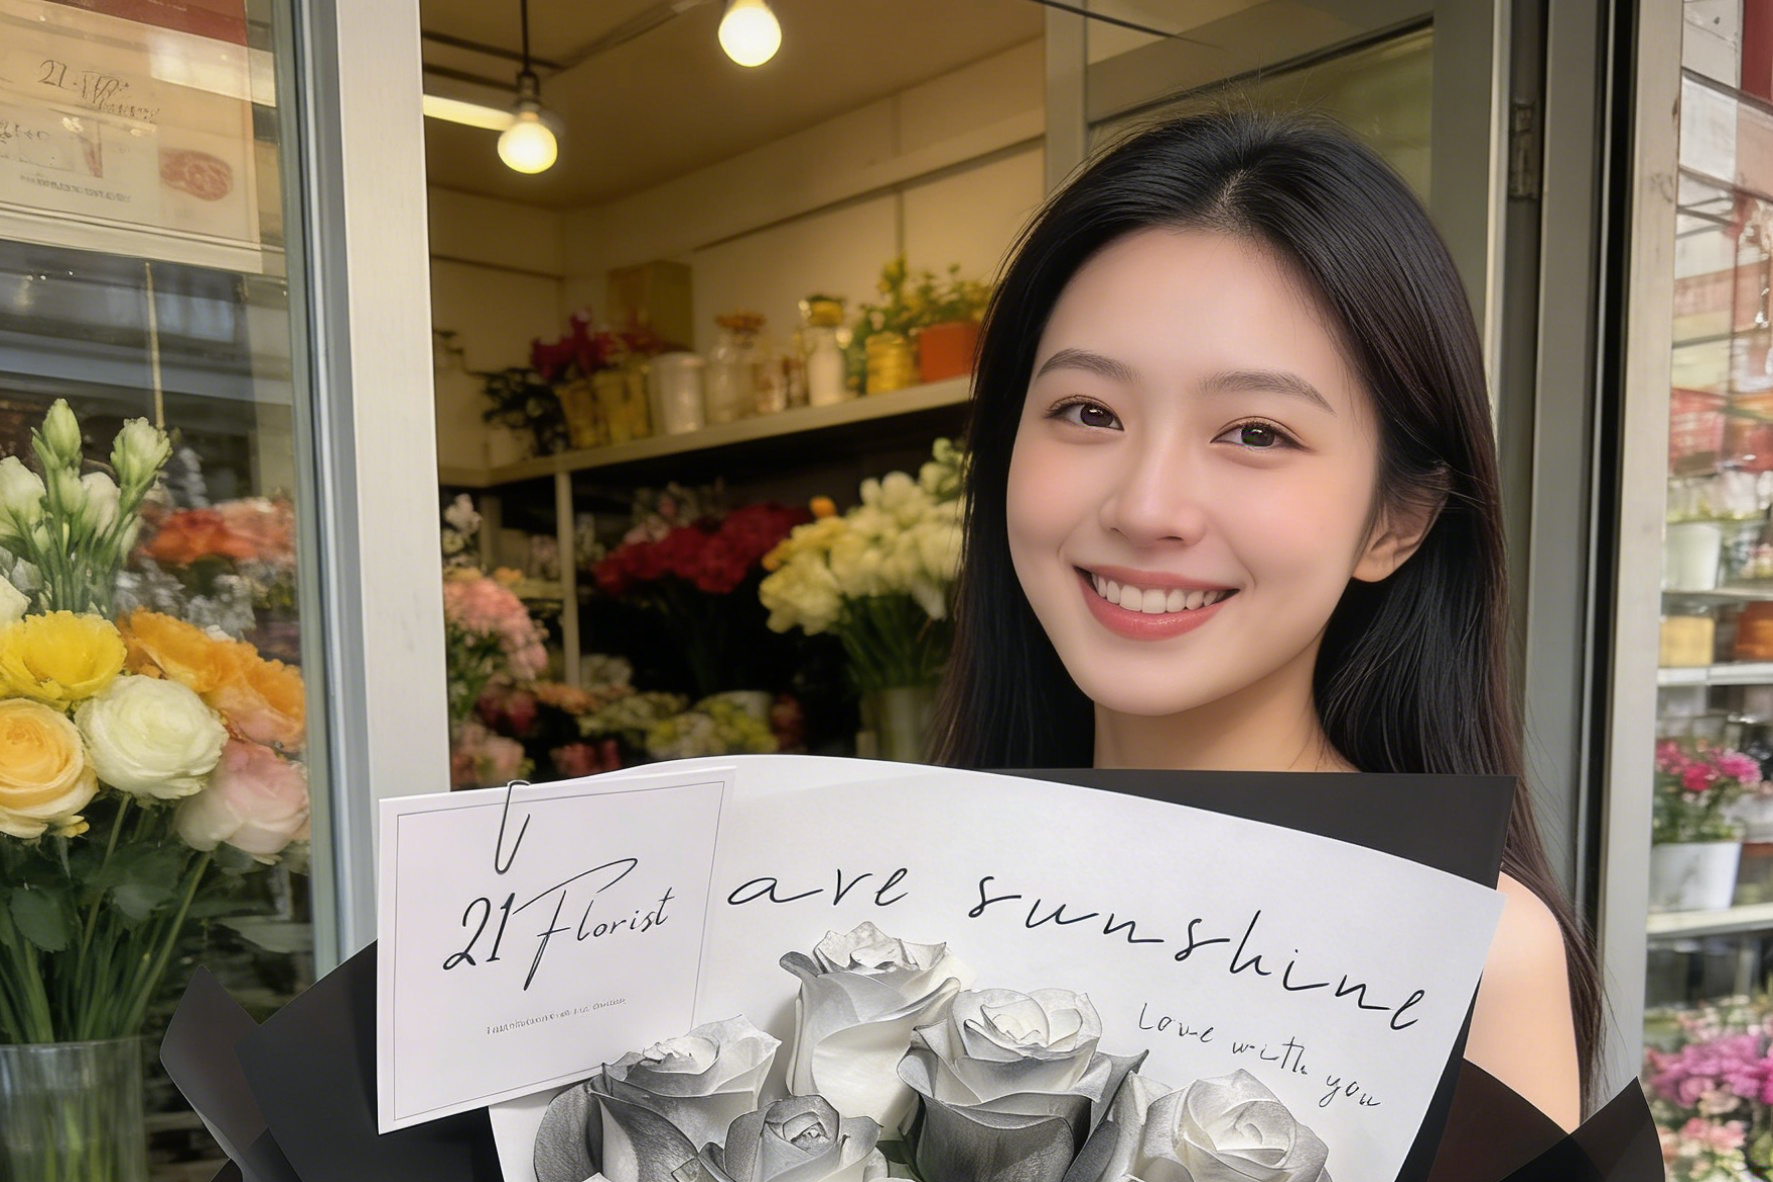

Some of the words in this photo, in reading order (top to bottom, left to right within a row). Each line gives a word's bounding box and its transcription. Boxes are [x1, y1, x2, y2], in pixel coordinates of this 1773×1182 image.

[442, 891, 516, 971] 21
[513, 857, 676, 992] Florist
[727, 865, 909, 907] are
[967, 875, 1426, 1031] sunshine
[1138, 1002, 1217, 1044] Love
[1318, 1074, 1383, 1109] you
